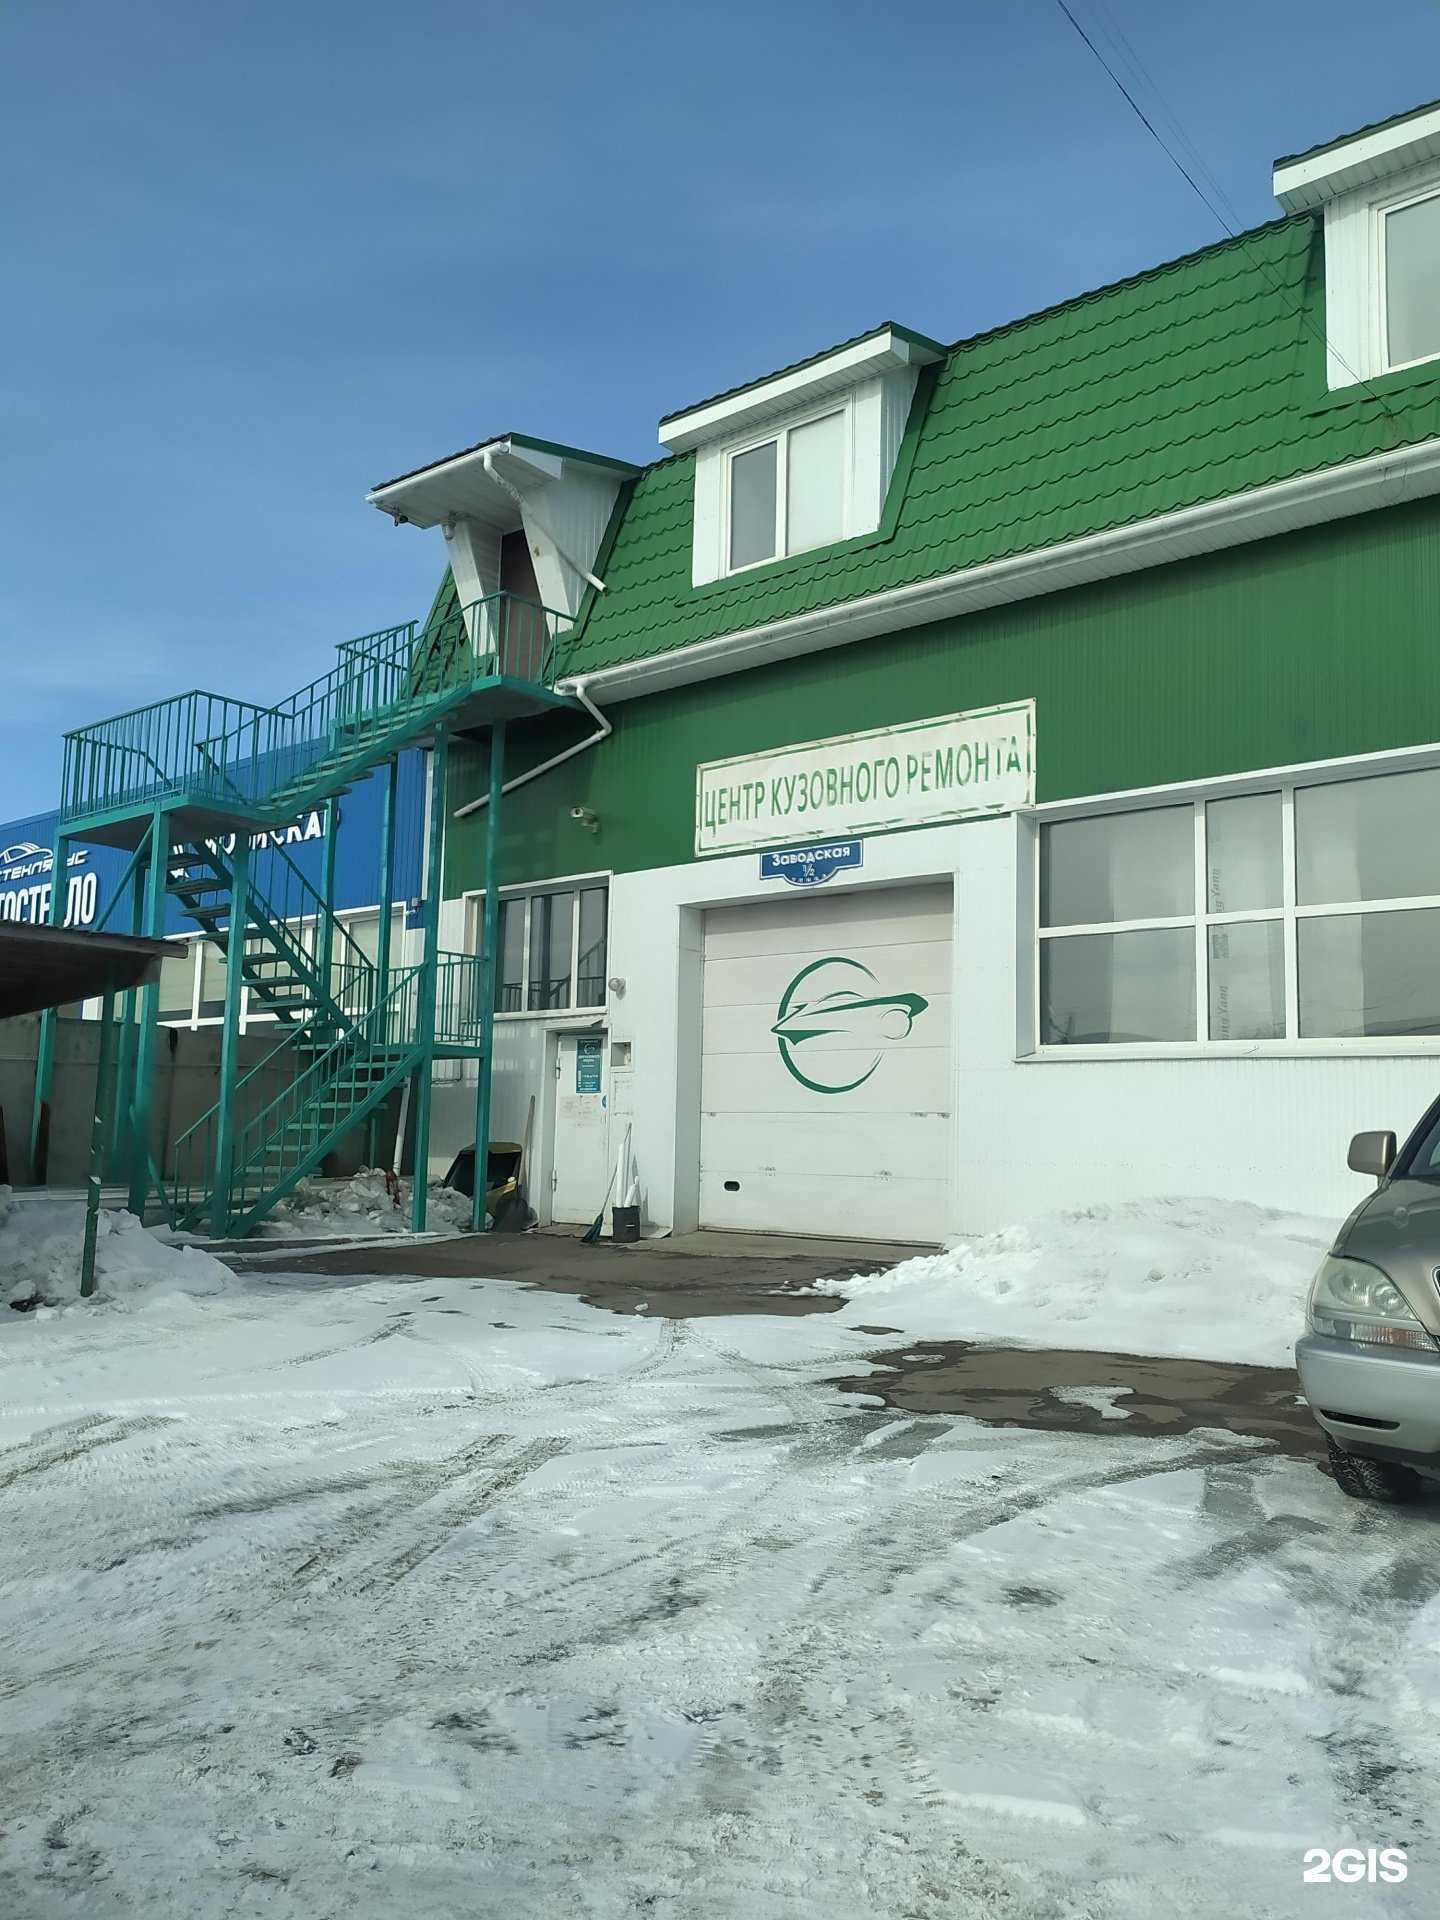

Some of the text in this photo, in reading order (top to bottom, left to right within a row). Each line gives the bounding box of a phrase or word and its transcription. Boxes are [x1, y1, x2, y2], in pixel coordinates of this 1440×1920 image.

[705, 736, 1022, 837] ЦЕНТР КУЗОВНОГО РЕМОНТА
[772, 846, 851, 867] Заводская
